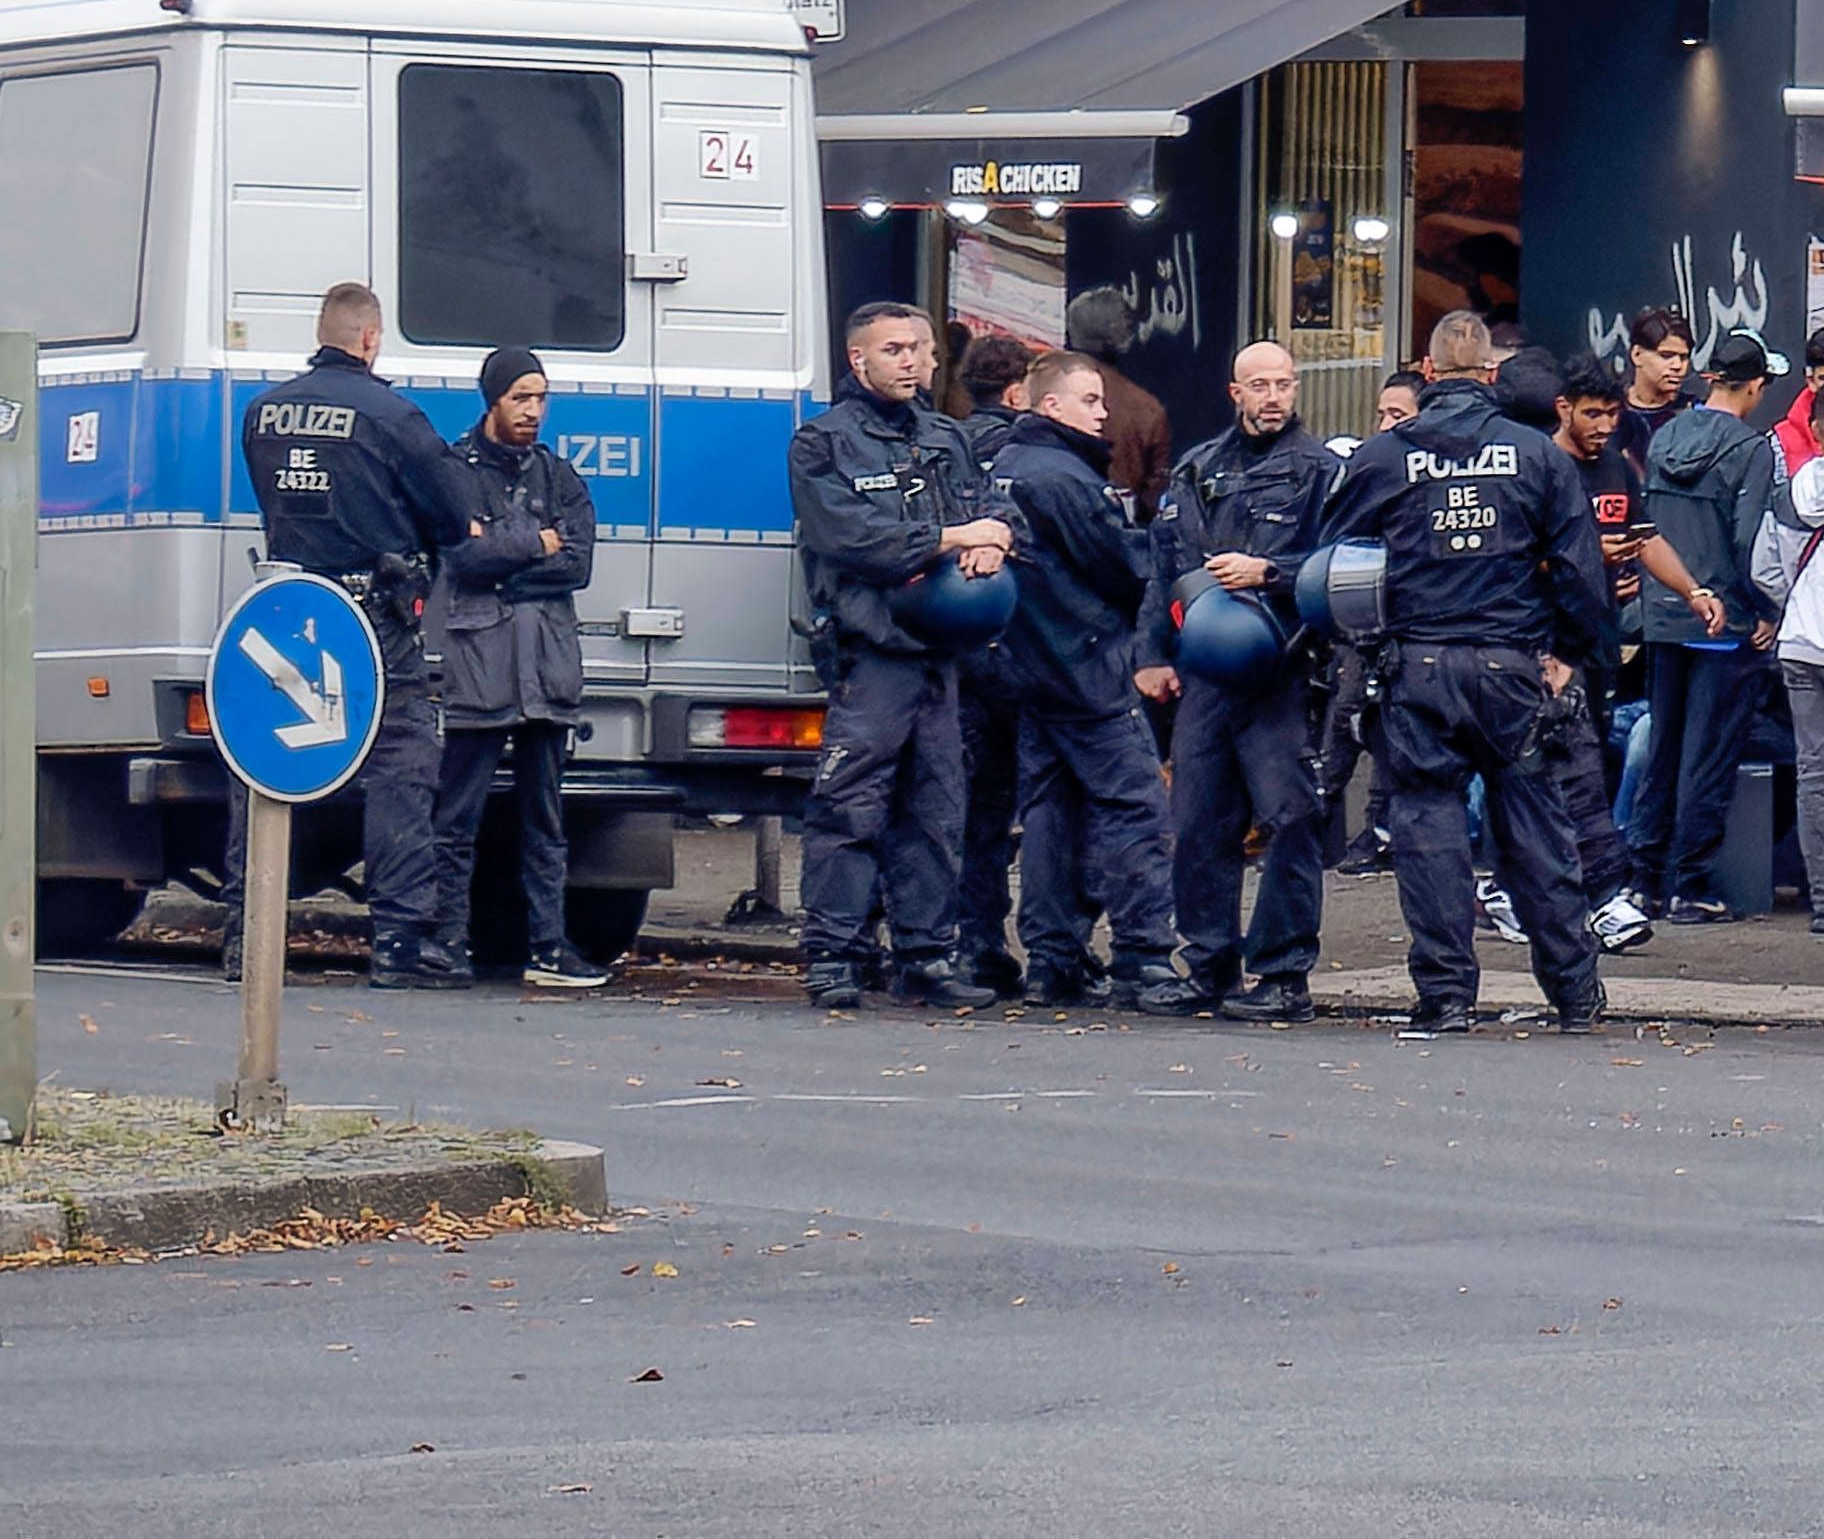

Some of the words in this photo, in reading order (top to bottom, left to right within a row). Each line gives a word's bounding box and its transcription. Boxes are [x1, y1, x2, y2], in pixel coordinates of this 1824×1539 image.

[705, 136, 753, 174] 24
[1000, 163, 1081, 193] CHICKEN
[258, 403, 356, 439] POLIZEI
[289, 447, 319, 469] BE
[557, 434, 641, 478] IZEI
[1405, 444, 1519, 483] POLIZEI
[1447, 485, 1480, 508] BE
[1431, 506, 1497, 532] 24320
